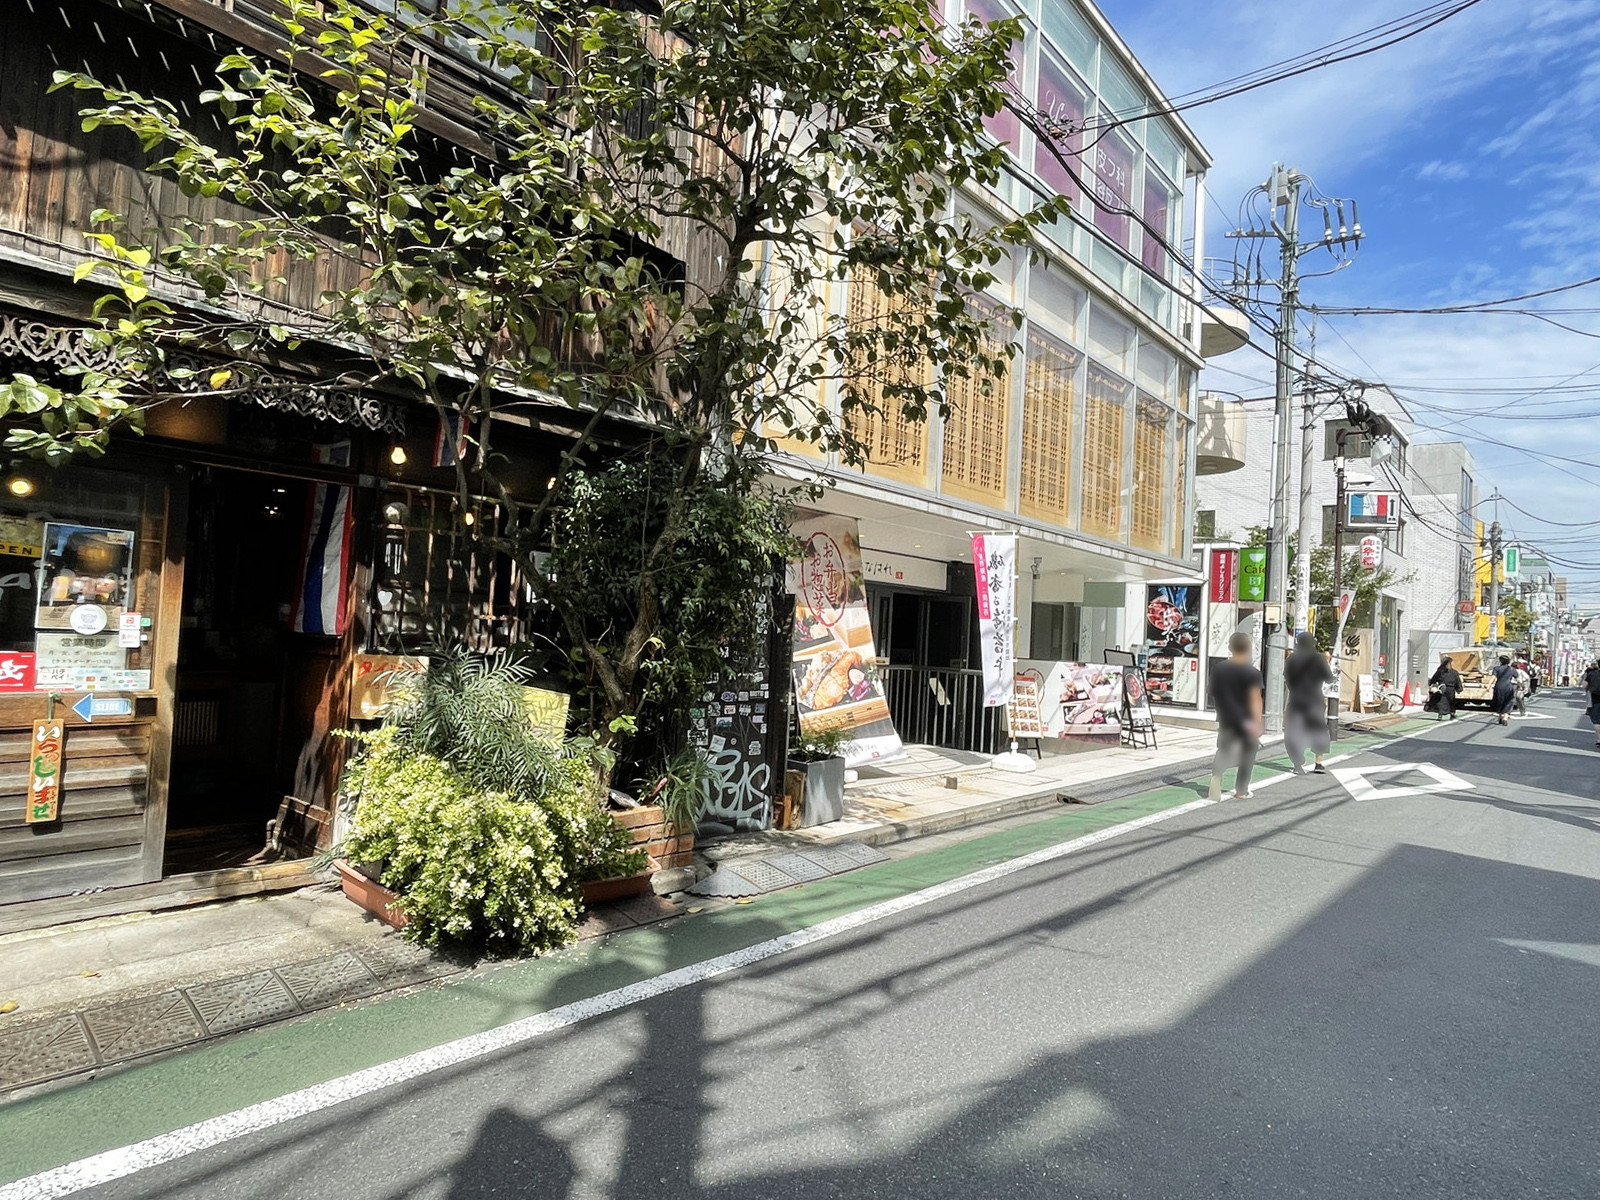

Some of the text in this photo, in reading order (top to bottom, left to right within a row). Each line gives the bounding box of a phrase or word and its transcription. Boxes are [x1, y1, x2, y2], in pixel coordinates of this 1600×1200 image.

[823, 542, 838, 605] お弁当
[1249, 576, 1262, 586] B1
[60, 638, 107, 648] 営業時間
